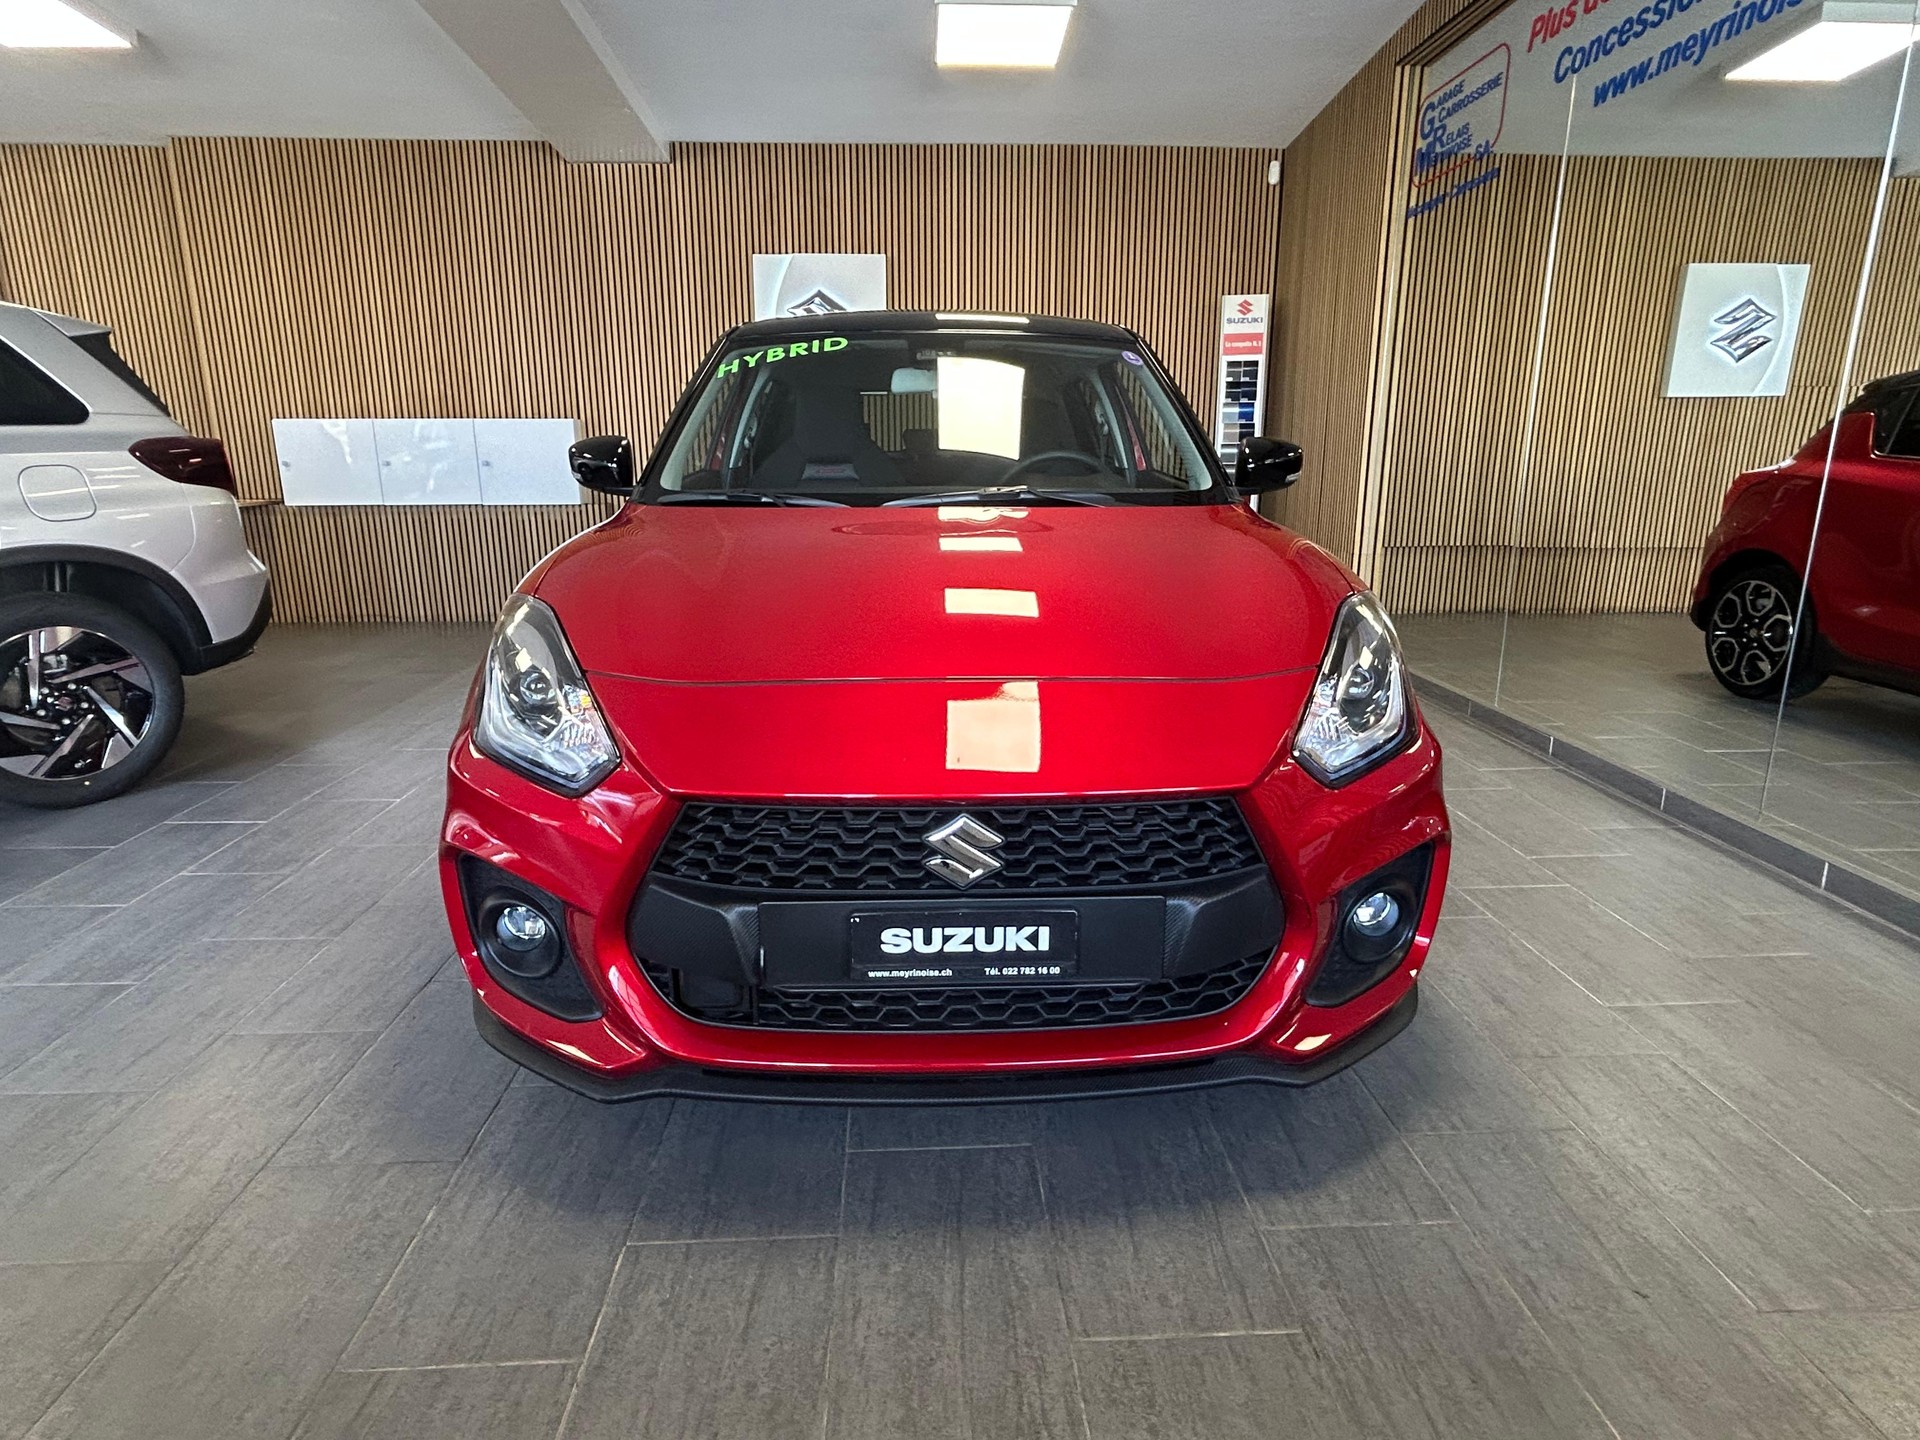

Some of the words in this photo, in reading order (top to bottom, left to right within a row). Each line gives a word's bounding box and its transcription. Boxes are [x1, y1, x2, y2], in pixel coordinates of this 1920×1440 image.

[1526, 0, 1579, 53] Plus
[1554, 0, 1701, 84] Concessi
[1594, 0, 1803, 107] www.meyrino
[1419, 78, 1466, 140] GARAGE
[1438, 71, 1504, 123] CARROSSERIE
[1432, 122, 1470, 150] RELAIS
[717, 337, 849, 379] HYBRID
[880, 926, 1050, 953] SUZUKI
[867, 968, 953, 979] www.meyrinoise.ch
[1002, 967, 1019, 976] 022
[1020, 966, 1036, 975] 782
[1049, 966, 1061, 975] 00
